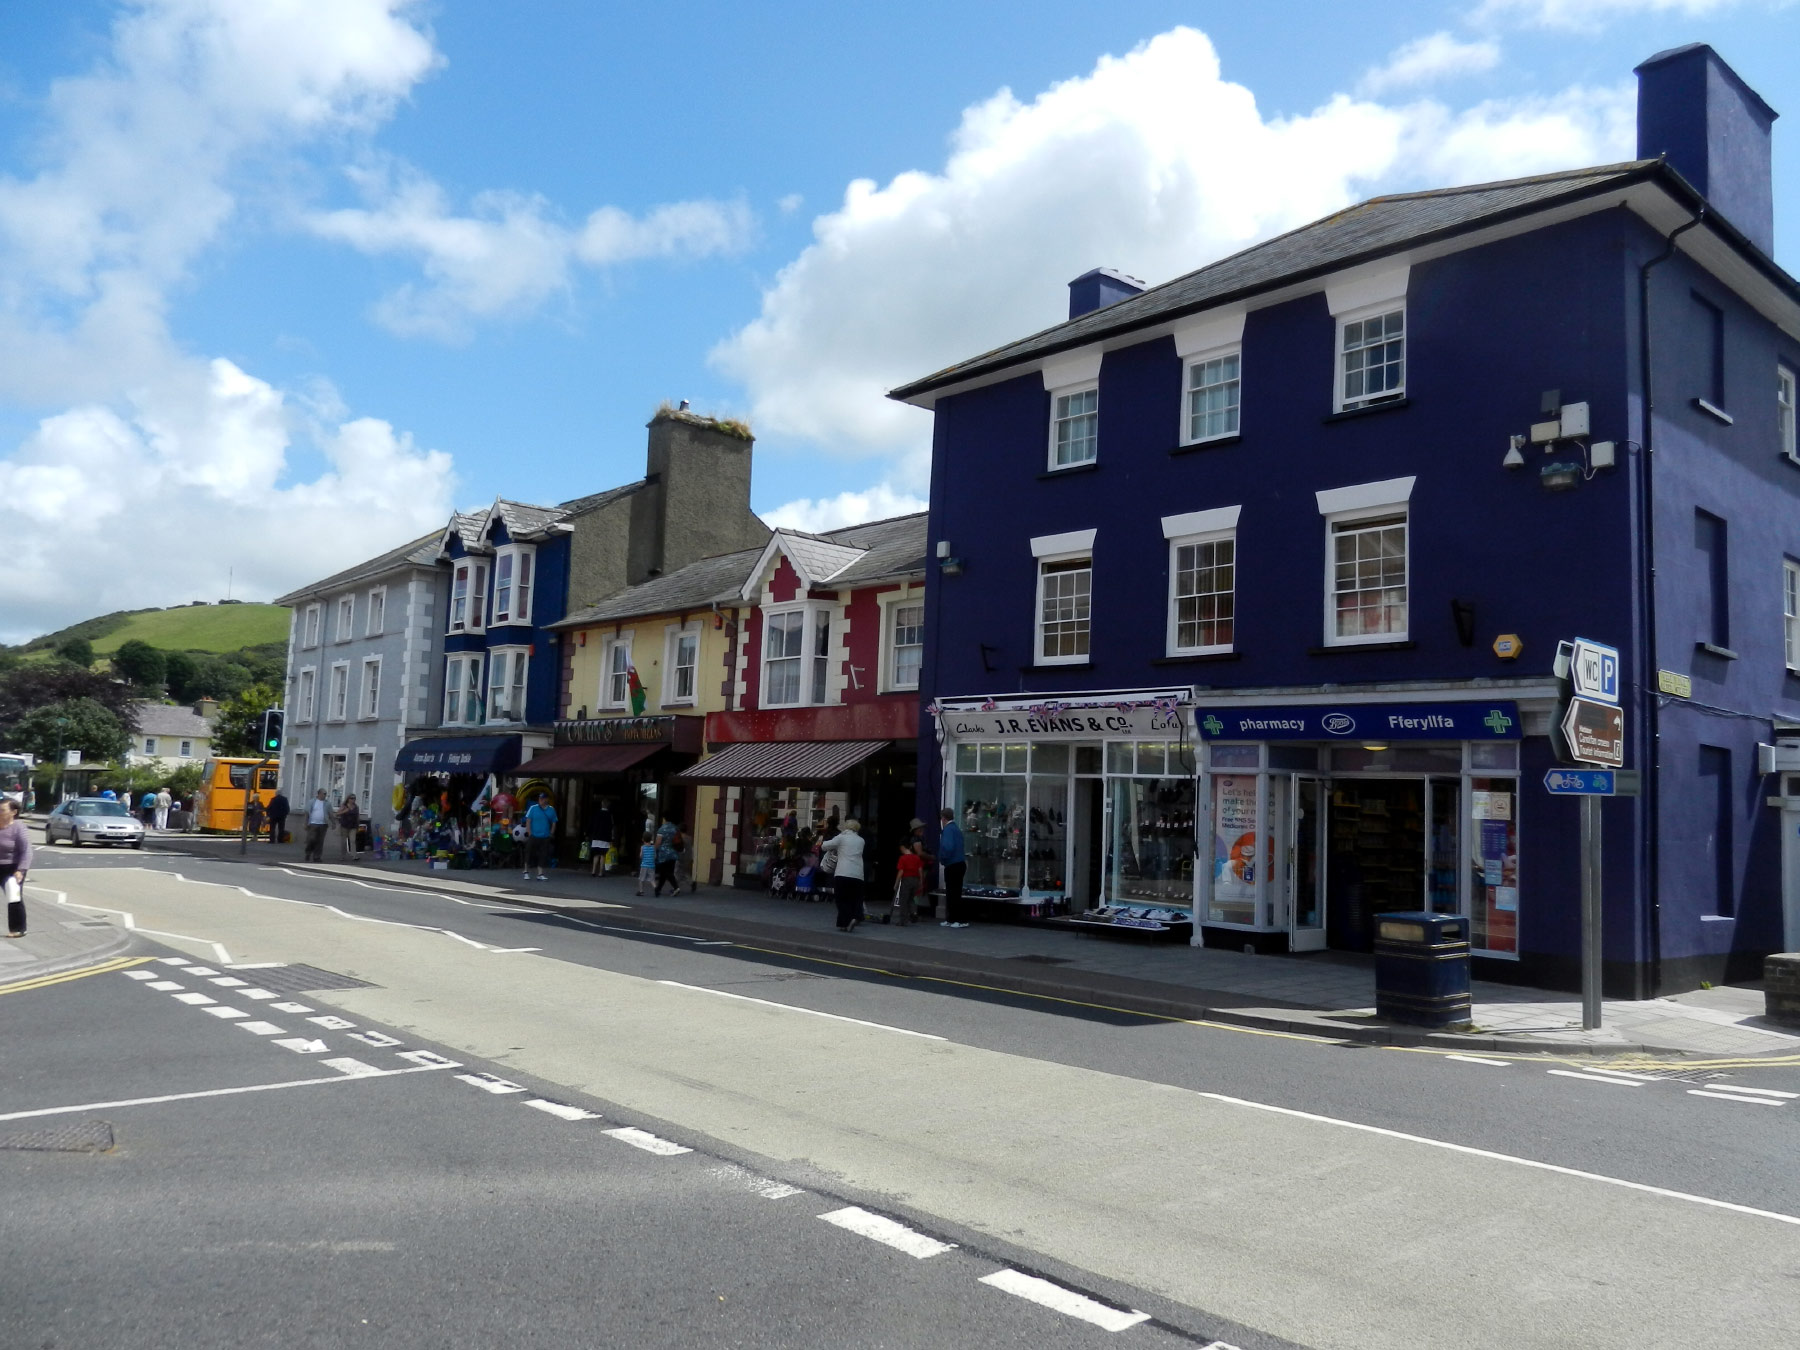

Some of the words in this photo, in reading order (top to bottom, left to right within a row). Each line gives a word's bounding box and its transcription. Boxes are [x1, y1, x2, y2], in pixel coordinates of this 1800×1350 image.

[1585, 659, 1598, 682] WC
[1604, 659, 1613, 691] P
[956, 723, 985, 733] Clarks
[1087, 717, 1104, 732] &
[1151, 717, 1183, 731] Lotu
[1239, 718, 1305, 732] pharmacy
[1388, 714, 1455, 730] Fferyllfa
[1222, 788, 1241, 796] Let's
[1222, 797, 1244, 805] make
